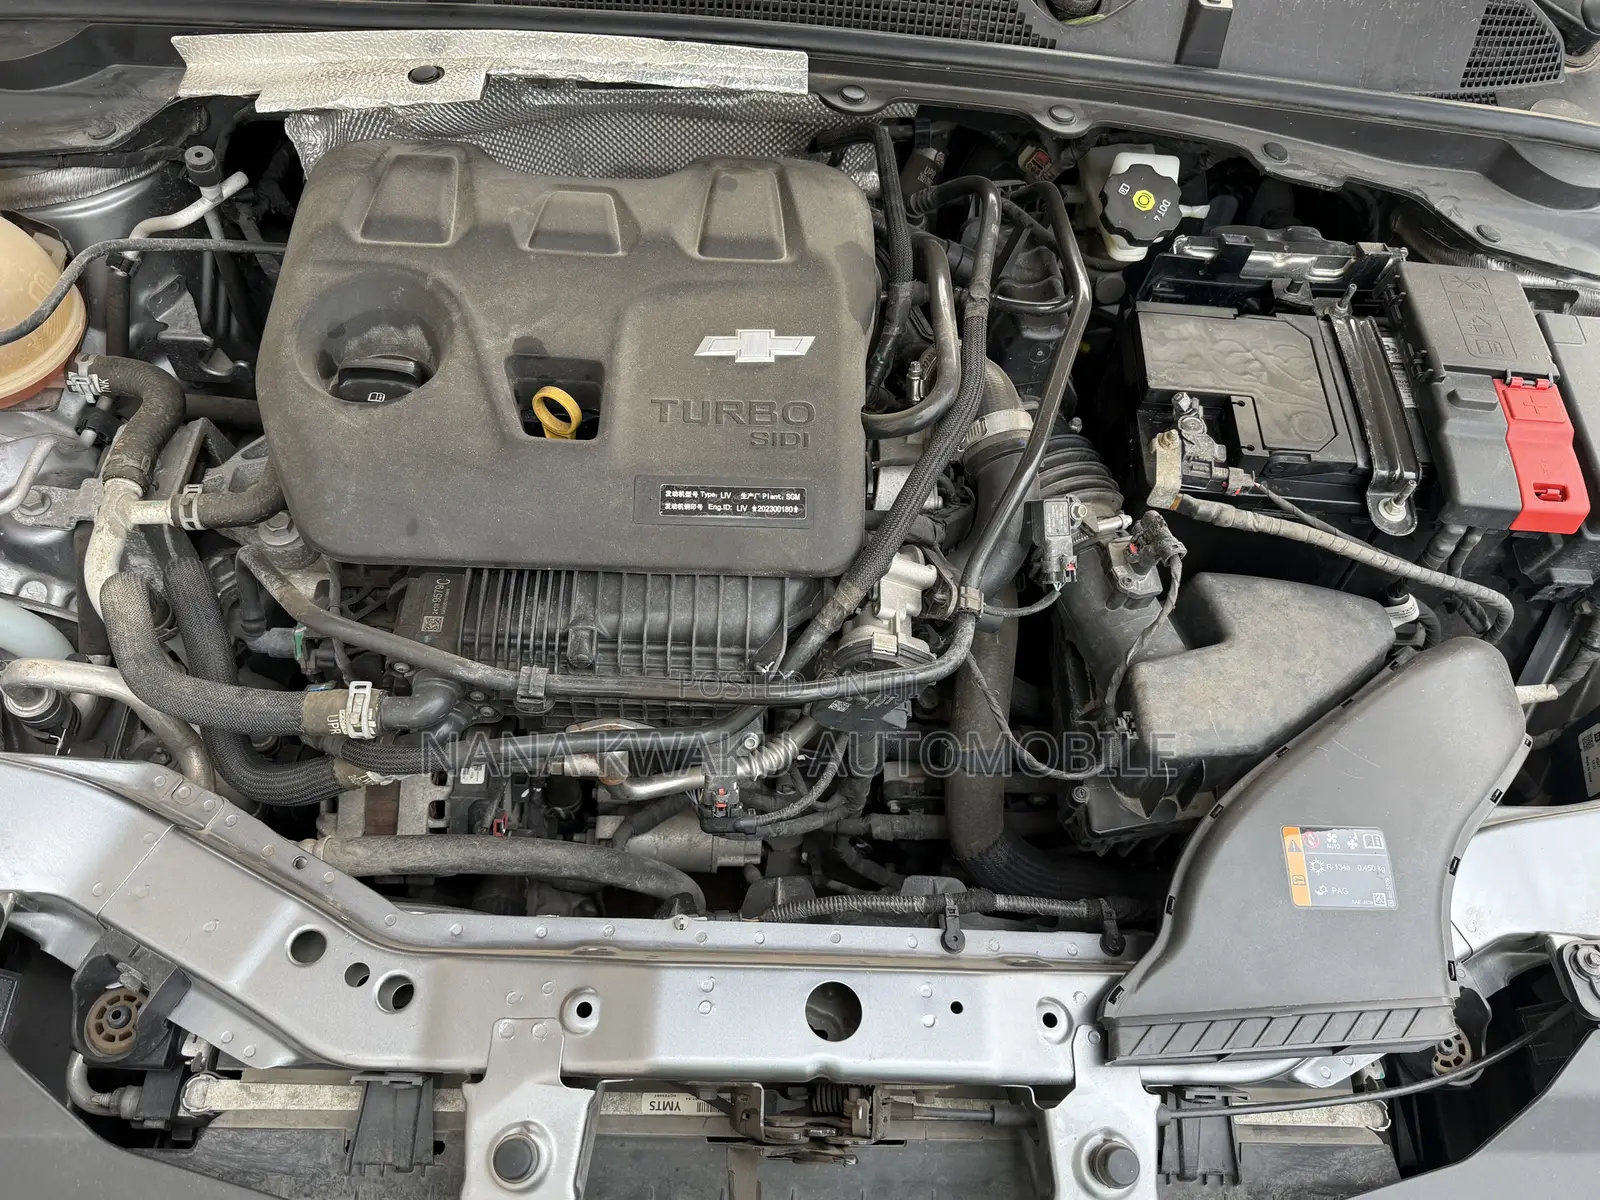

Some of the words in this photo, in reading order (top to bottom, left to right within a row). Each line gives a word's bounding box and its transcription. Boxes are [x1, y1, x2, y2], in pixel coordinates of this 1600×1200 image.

[1157, 199, 1172, 217] DOT
[1153, 214, 1161, 222] 4
[650, 399, 817, 427] TURBO
[750, 431, 811, 448] SIDI
[786, 493, 801, 501] SGM
[327, 714, 342, 735] UPR
[1331, 887, 1349, 895] PAG
[649, 1100, 681, 1111] YMTS
